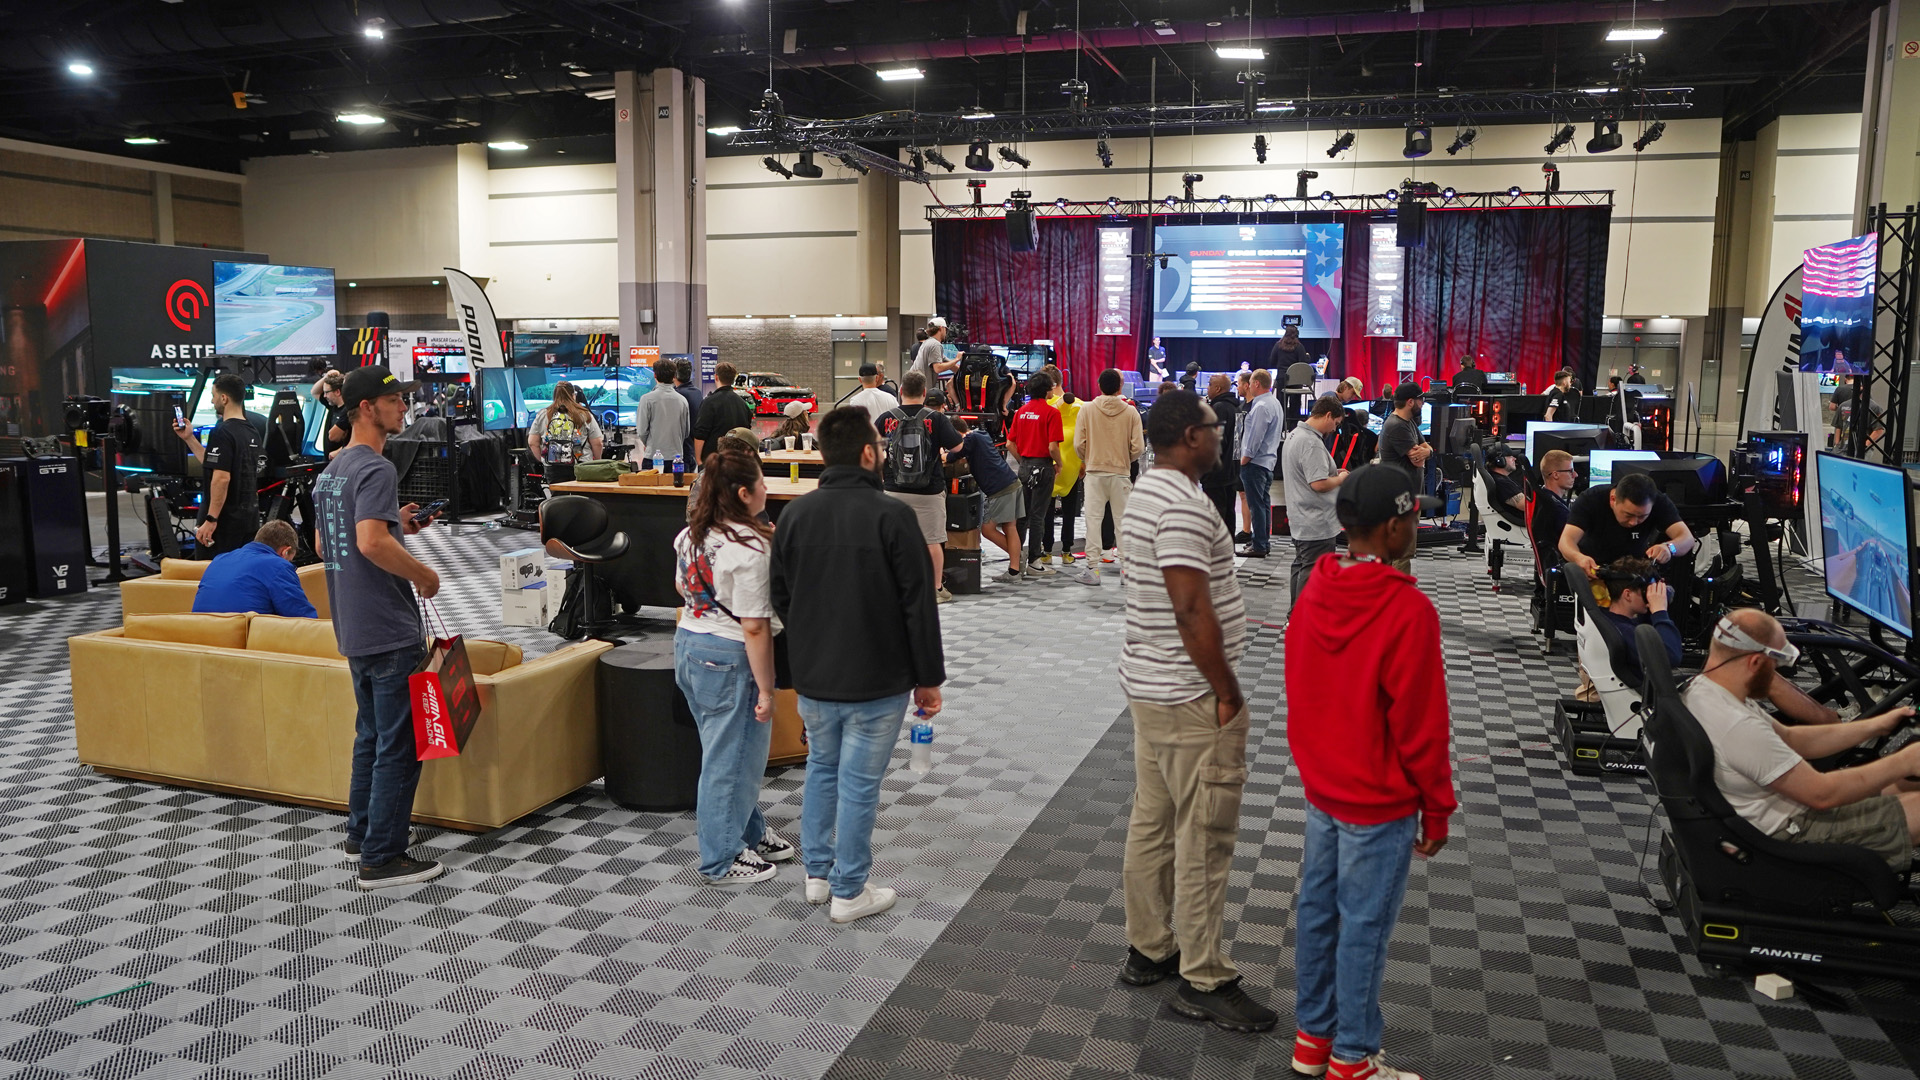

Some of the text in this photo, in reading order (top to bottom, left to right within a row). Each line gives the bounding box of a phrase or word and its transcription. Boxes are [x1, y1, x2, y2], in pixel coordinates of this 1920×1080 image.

[461, 303, 485, 370] PODIU
[150, 344, 215, 359] ASETE
[39, 466, 67, 475] GT3
[421, 692, 430, 714] KEEP
[425, 717, 435, 745] RACING
[1605, 762, 1647, 770] FANATE
[1750, 946, 1823, 963] FANATEC
